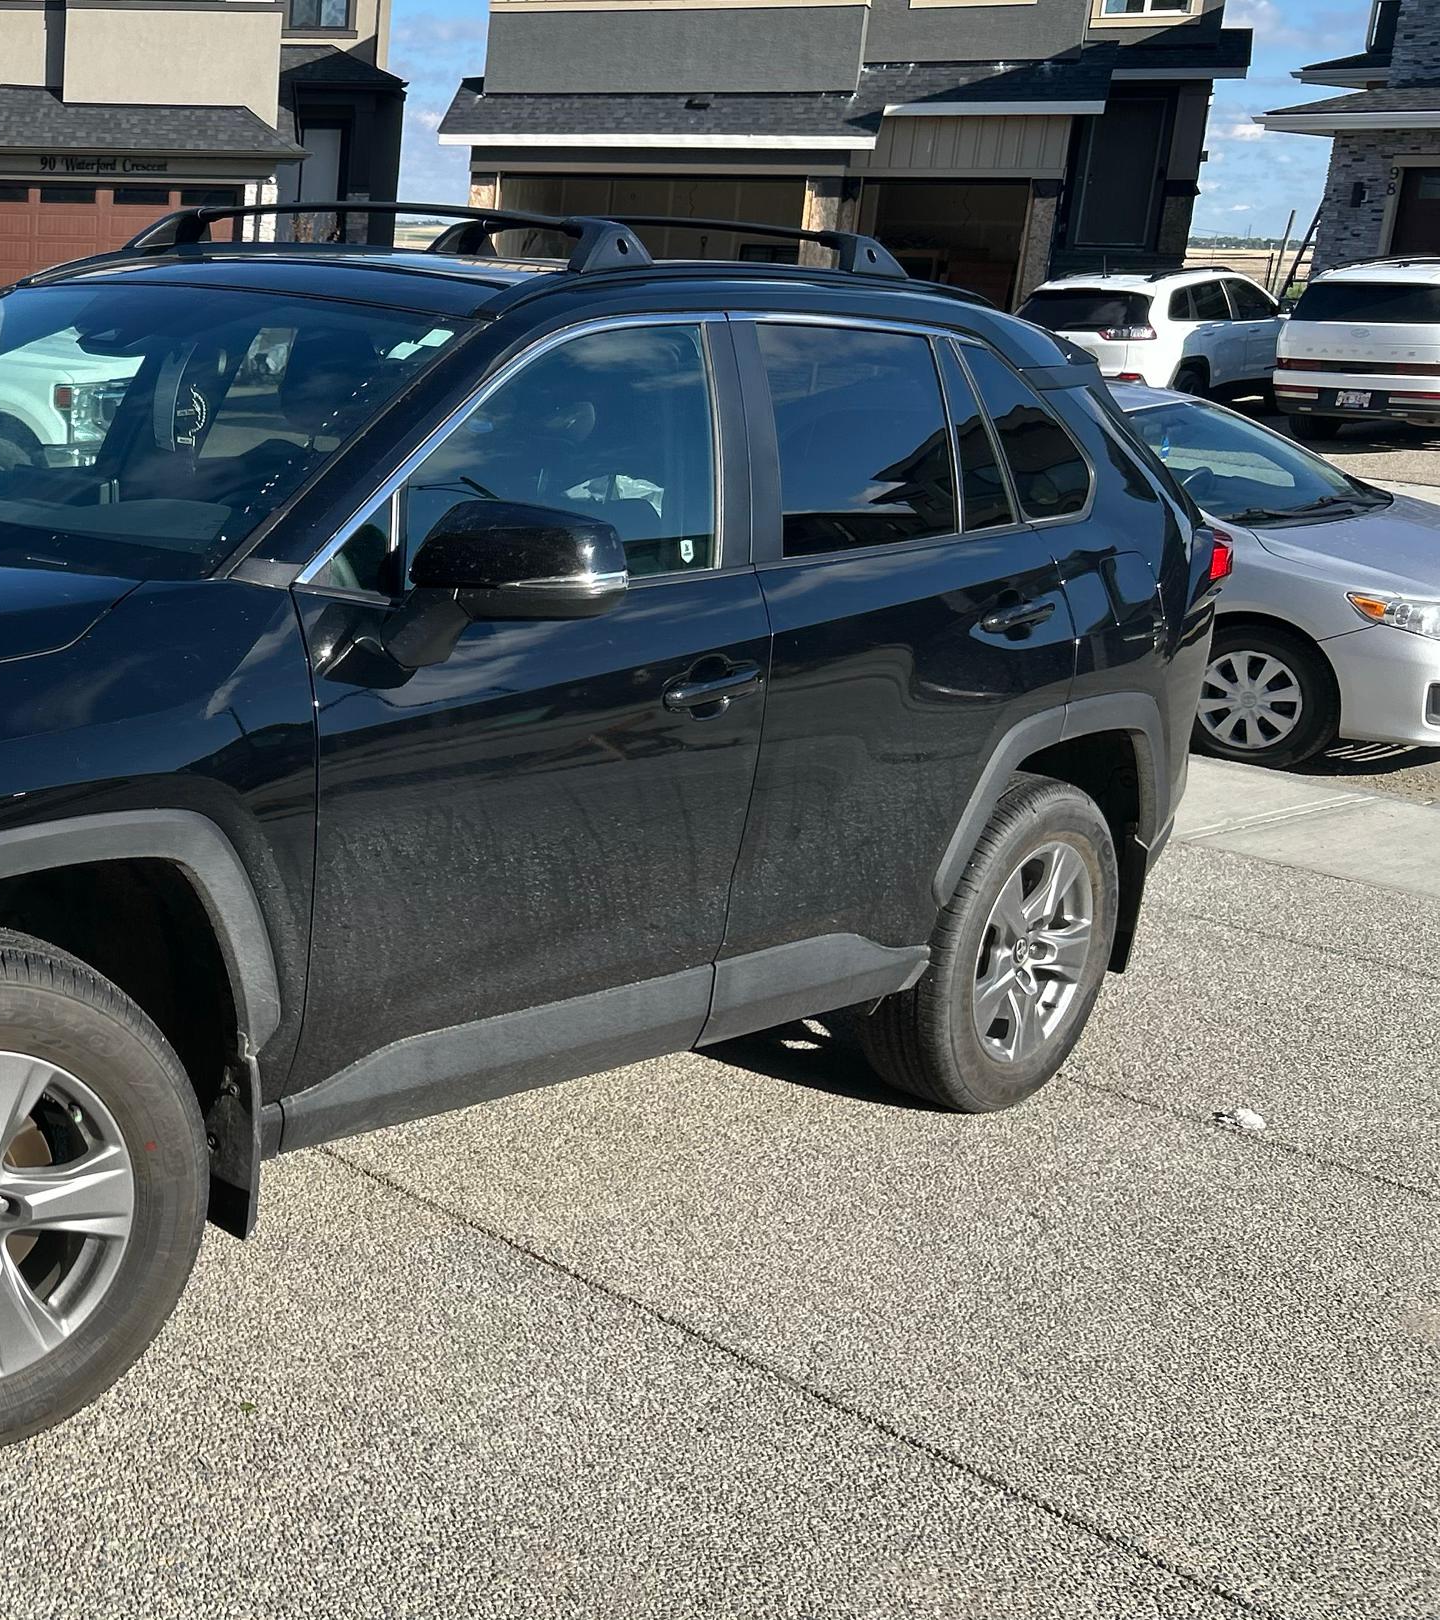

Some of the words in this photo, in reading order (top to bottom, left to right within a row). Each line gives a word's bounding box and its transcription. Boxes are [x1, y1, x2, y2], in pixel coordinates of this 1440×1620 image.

[40, 156, 56, 171] 90
[61, 157, 117, 174] Waterford
[122, 158, 168, 172] Crescent
[1306, 347, 1374, 355] SANTA
